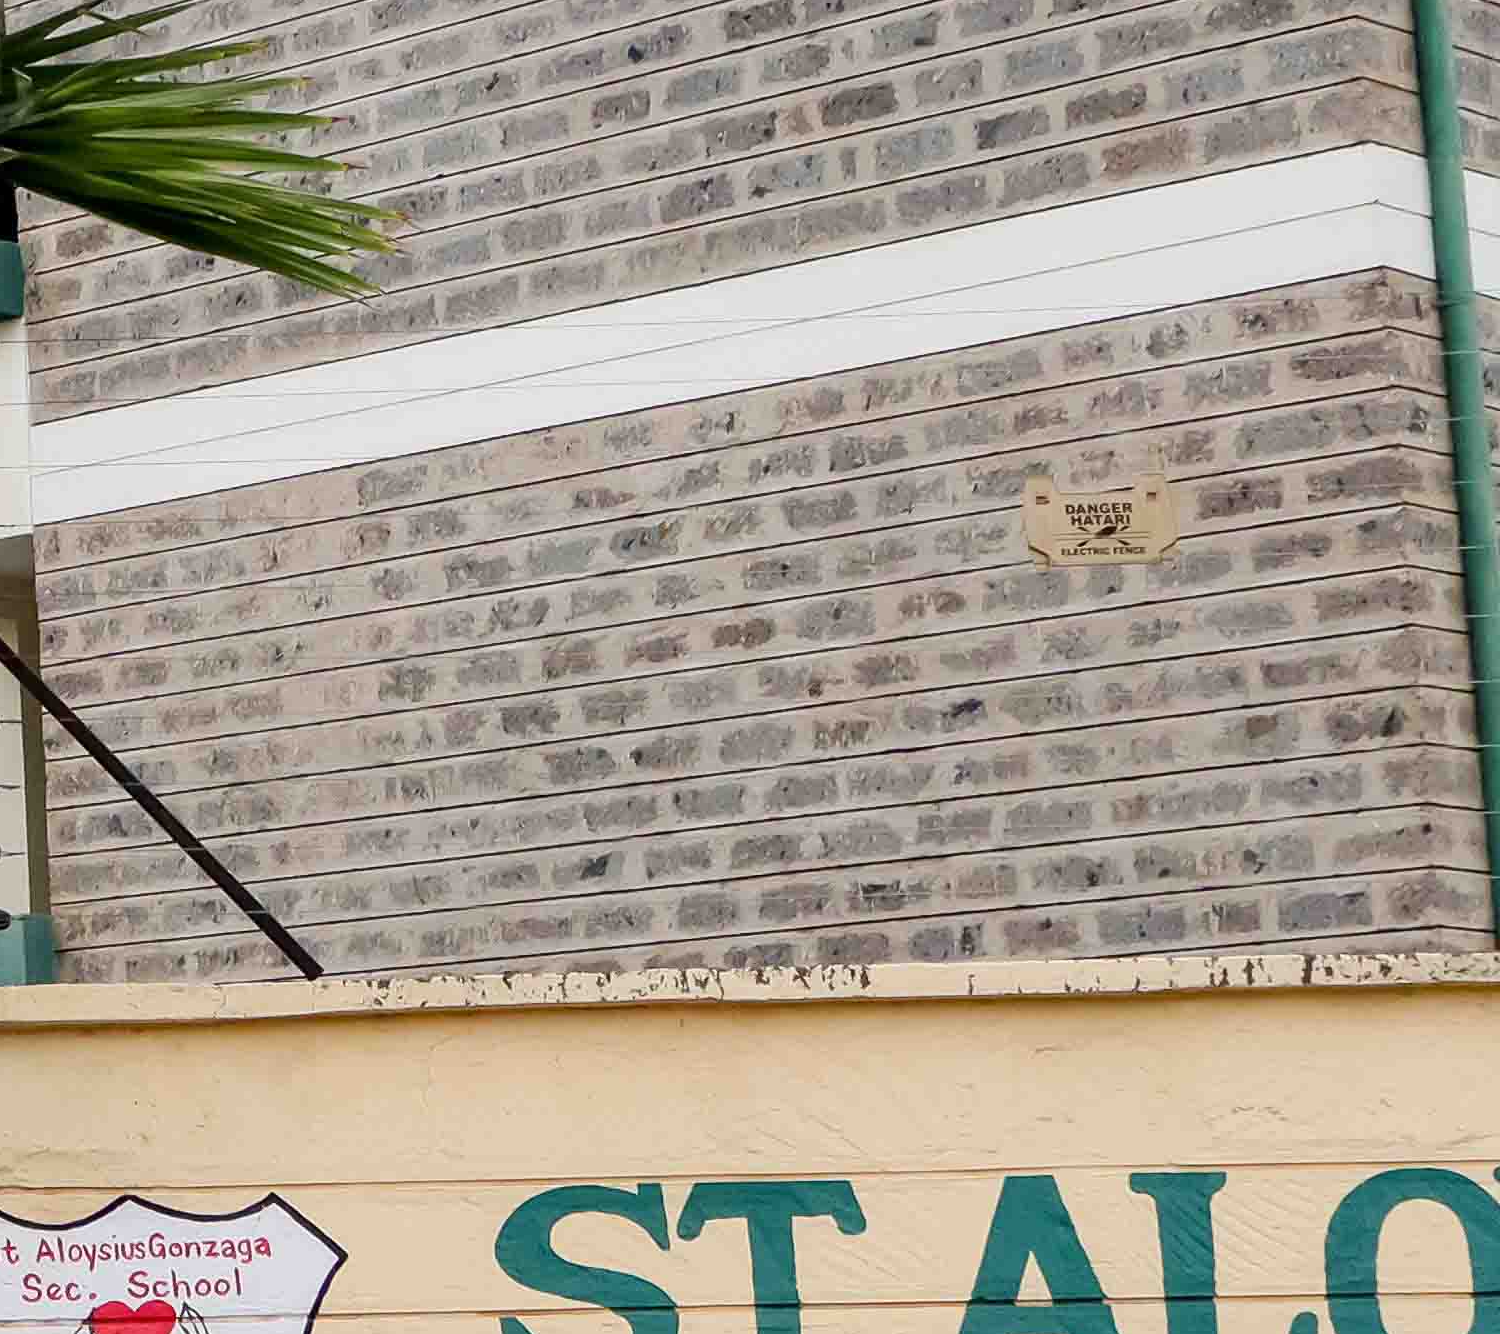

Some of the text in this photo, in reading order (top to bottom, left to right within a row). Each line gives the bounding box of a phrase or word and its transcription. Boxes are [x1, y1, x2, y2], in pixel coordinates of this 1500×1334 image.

[1065, 503, 1132, 515] DANGER
[1071, 514, 1131, 526] HATARI
[1061, 547, 1110, 555] ELECTRIC
[1113, 547, 1147, 555] FENCE
[22, 1268, 243, 1303] Sec. School
